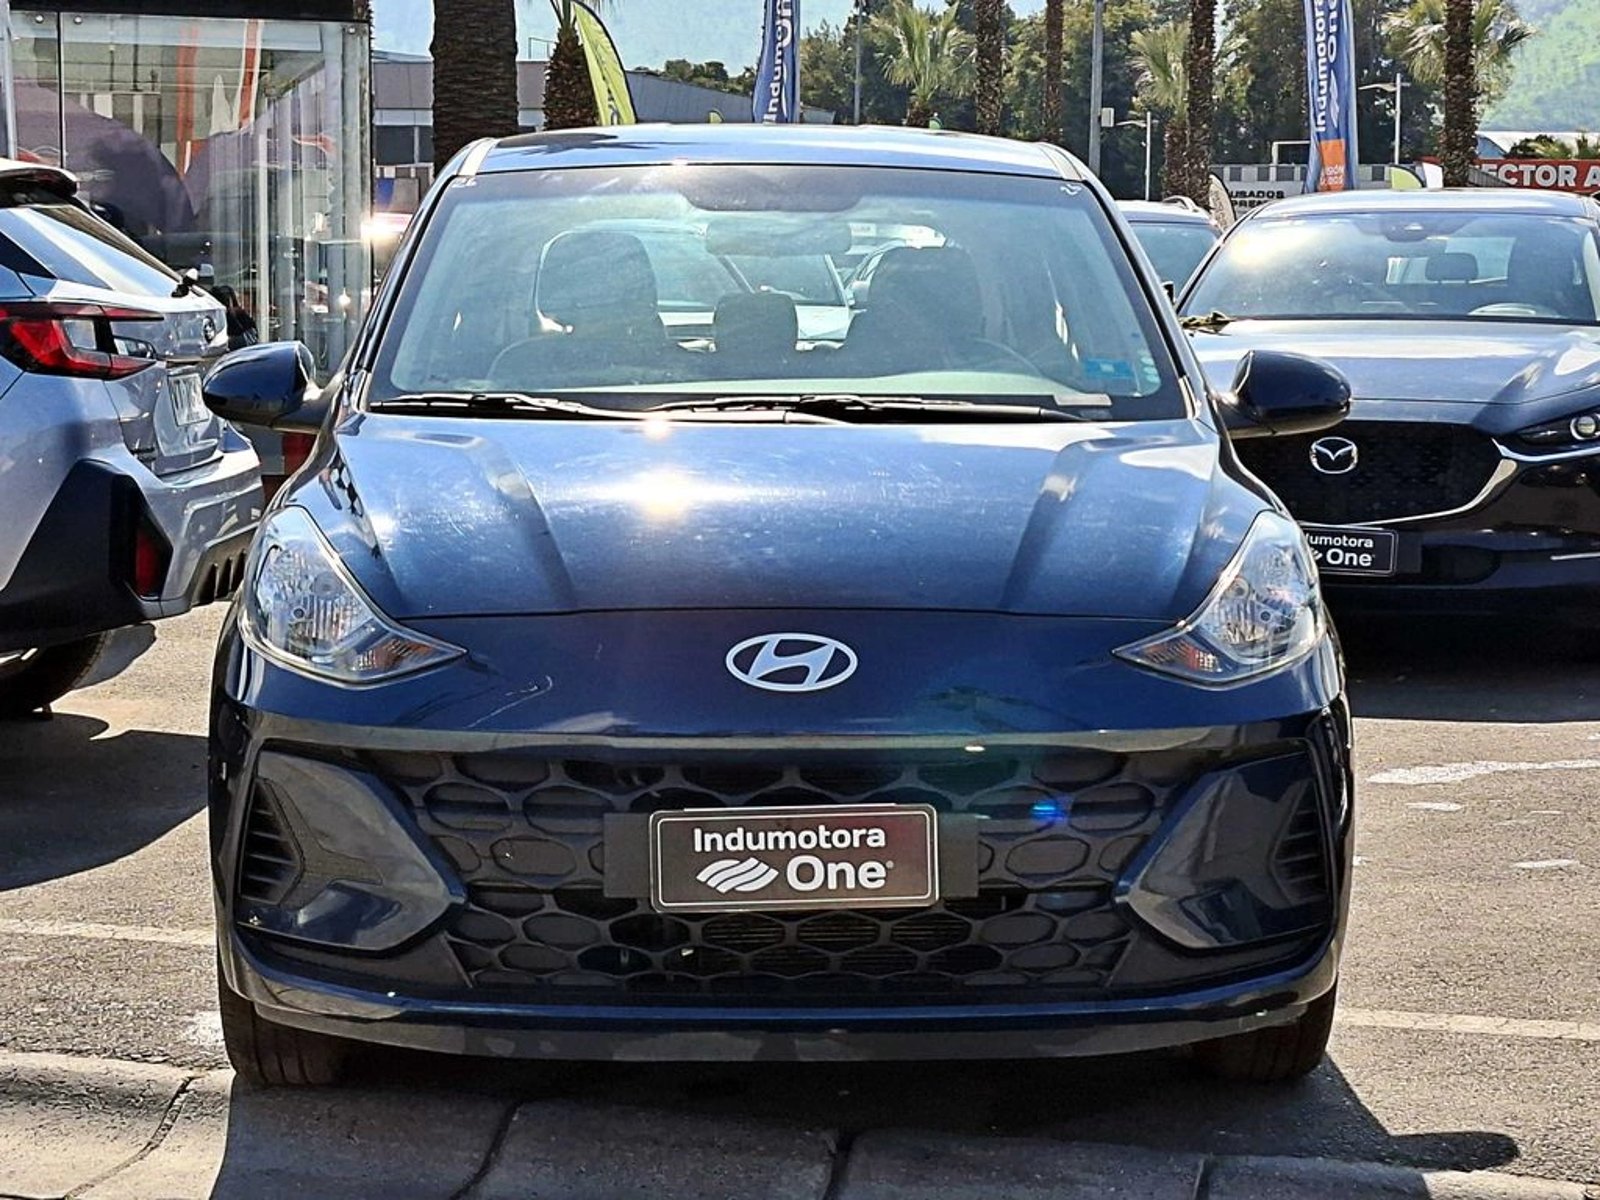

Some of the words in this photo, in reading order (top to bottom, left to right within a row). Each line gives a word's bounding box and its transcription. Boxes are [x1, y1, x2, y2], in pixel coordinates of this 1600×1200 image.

[1474, 163, 1578, 188] ECTOR
[1229, 189, 1285, 199] USADOS
[1325, 547, 1373, 567] One
[693, 824, 886, 853] Indumotora
[786, 854, 888, 892] One
